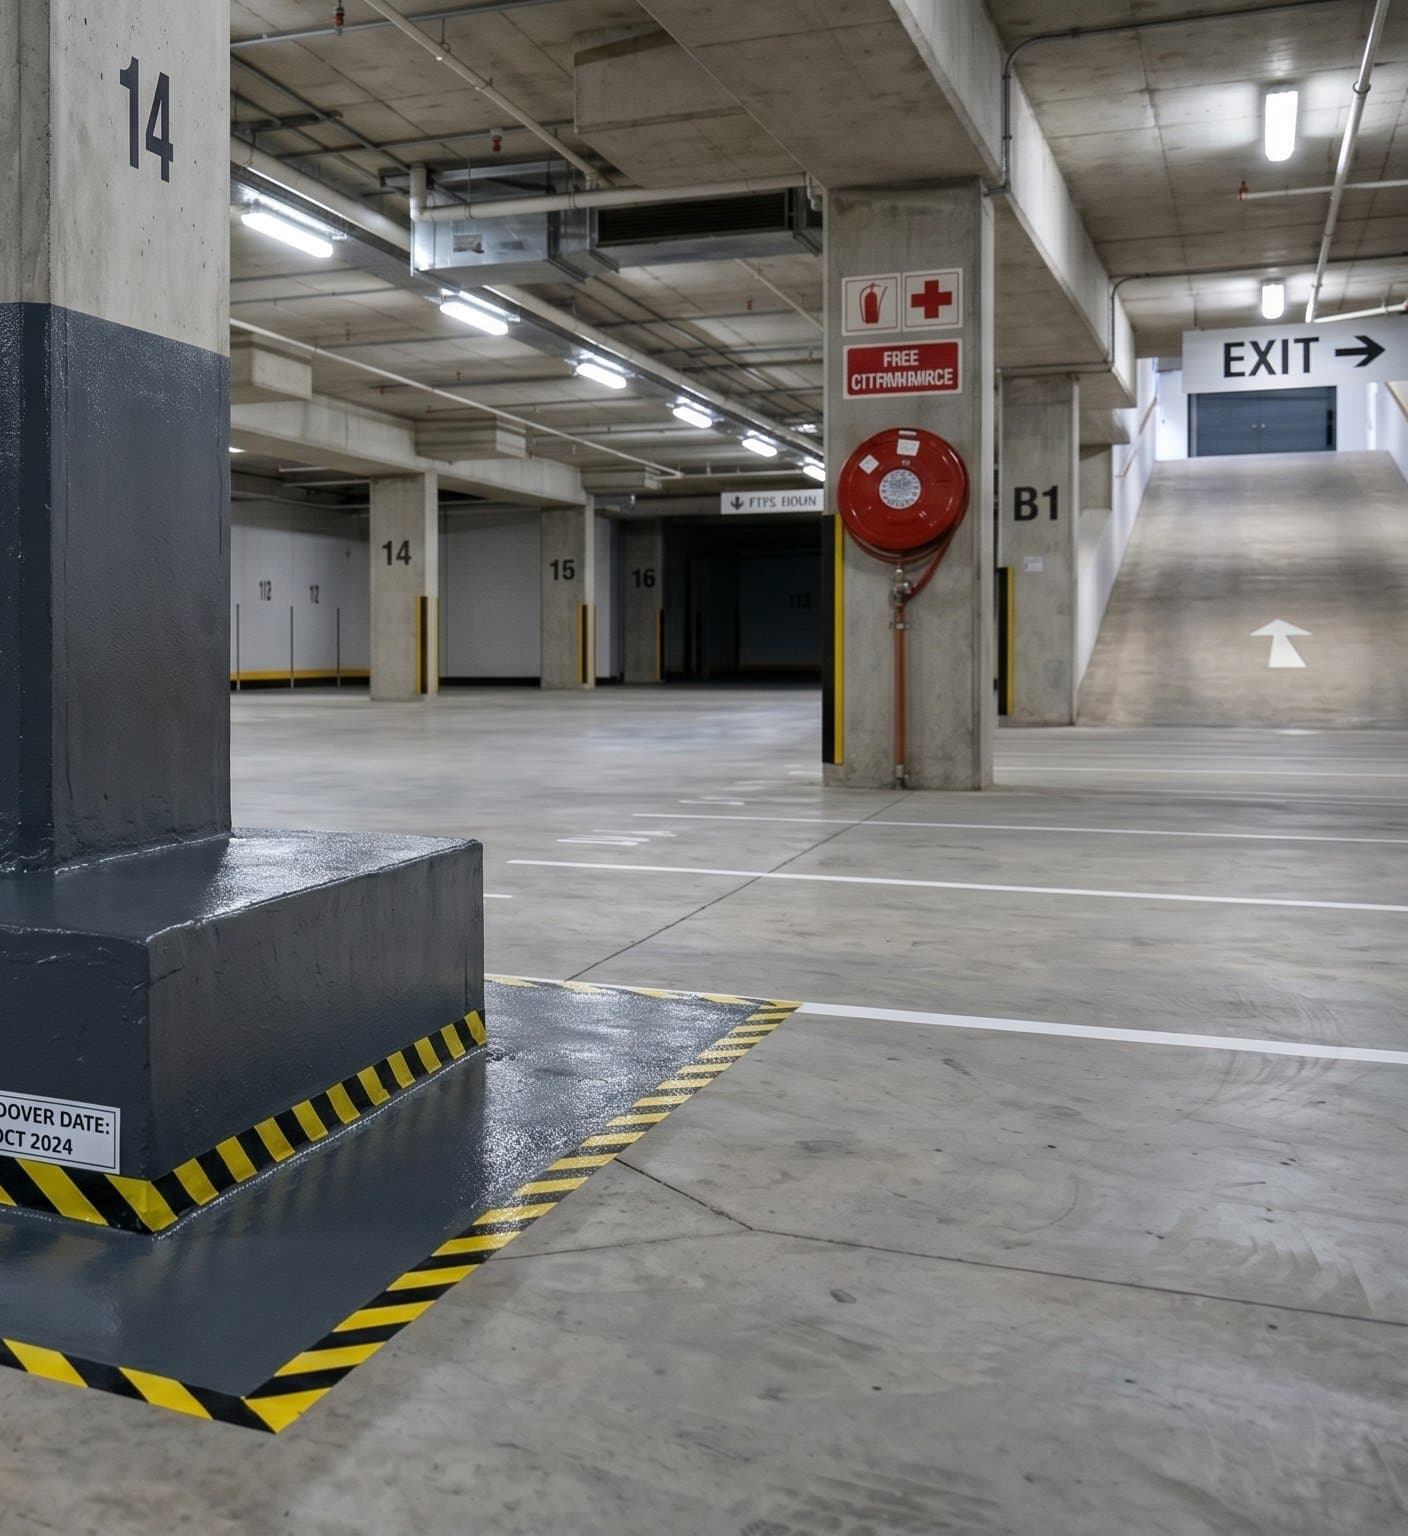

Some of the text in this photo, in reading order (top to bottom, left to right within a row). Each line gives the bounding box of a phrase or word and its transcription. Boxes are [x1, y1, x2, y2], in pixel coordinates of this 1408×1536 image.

[120, 56, 173, 183] 14
[884, 350, 918, 367] FREE
[1224, 337, 1319, 378] EXIT
[1014, 486, 1058, 521] B1
[382, 540, 411, 565] 14
[550, 560, 575, 580] 15
[632, 568, 655, 588] 16
[60, 1111, 110, 1134] DATE:
[30, 1133, 72, 1154] 2024
